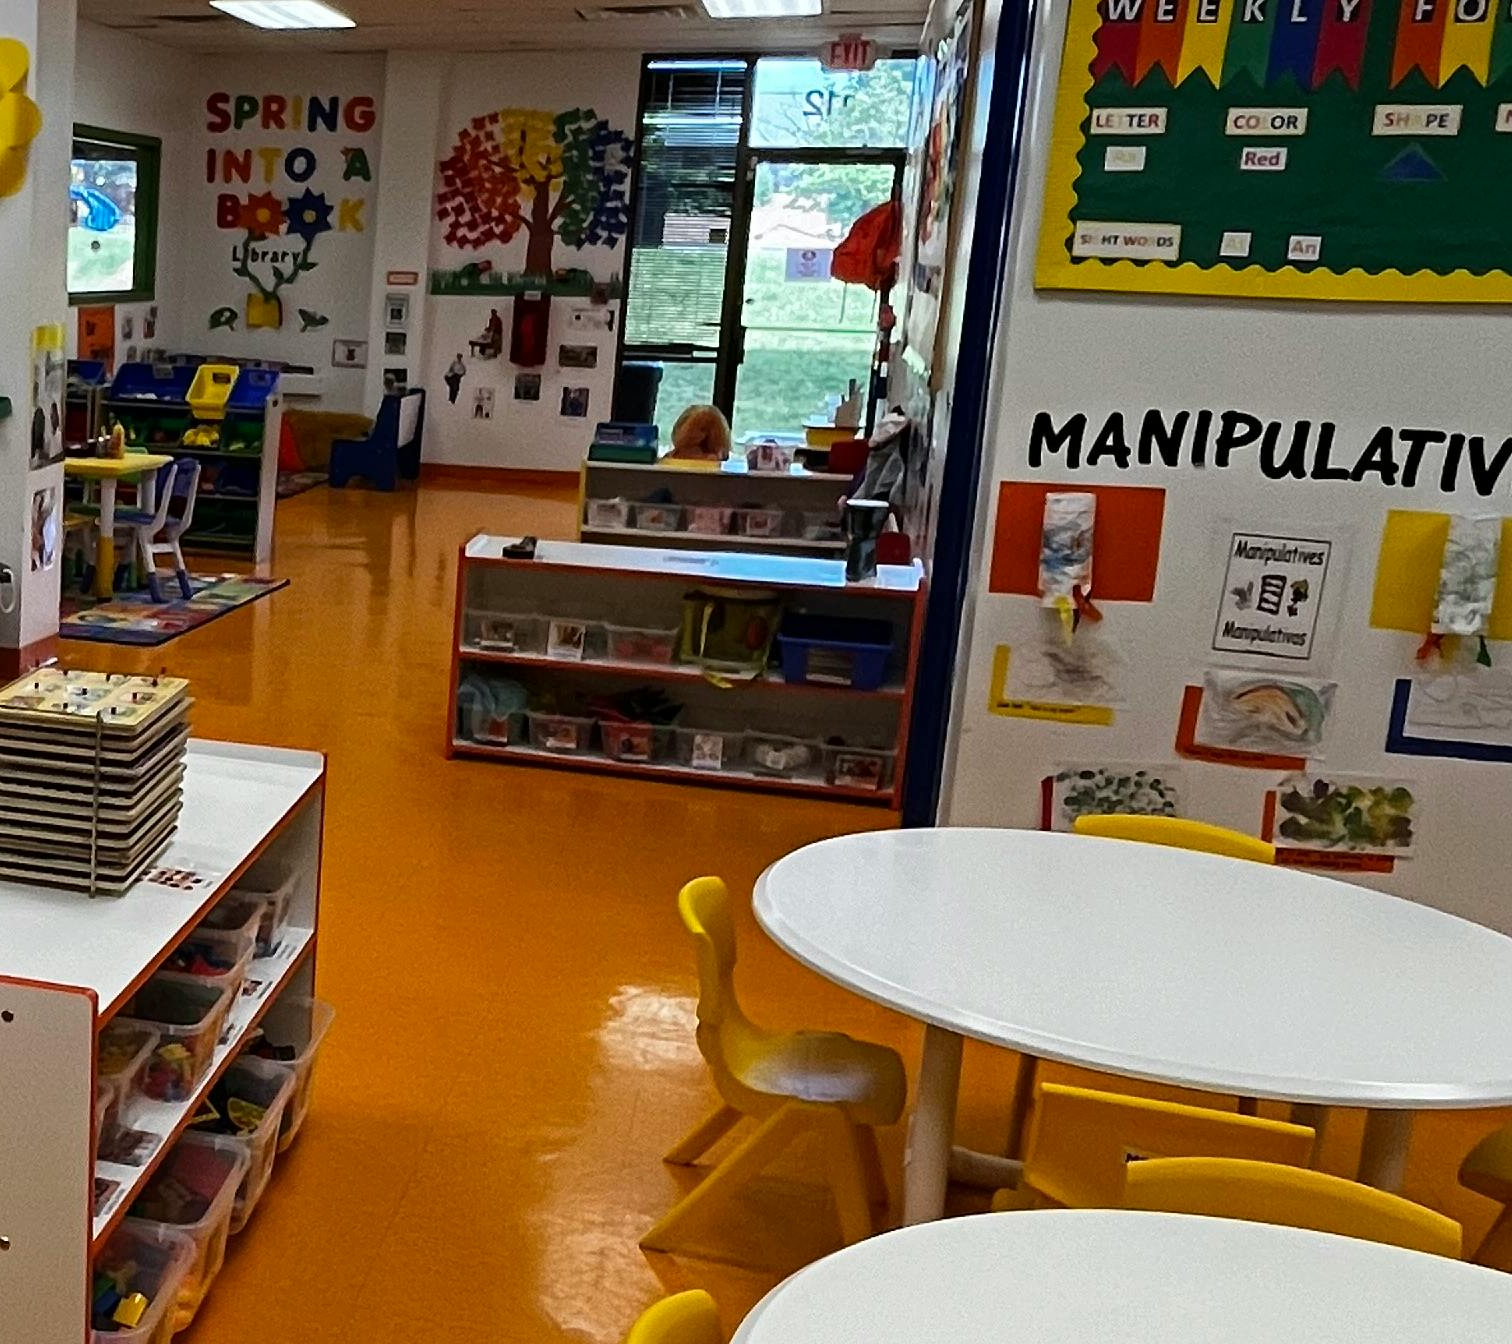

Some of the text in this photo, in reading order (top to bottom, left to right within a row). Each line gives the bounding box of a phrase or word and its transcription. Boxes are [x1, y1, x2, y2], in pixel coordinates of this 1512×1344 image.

[830, 41, 870, 66] EXIT
[206, 92, 376, 134] SPRING
[206, 146, 372, 184] INTO A
[1244, 151, 1281, 167] Red
[1290, 241, 1318, 255] An
[1028, 410, 1512, 497] MANIPULATIV
[1232, 539, 1325, 565] Manipulatives
